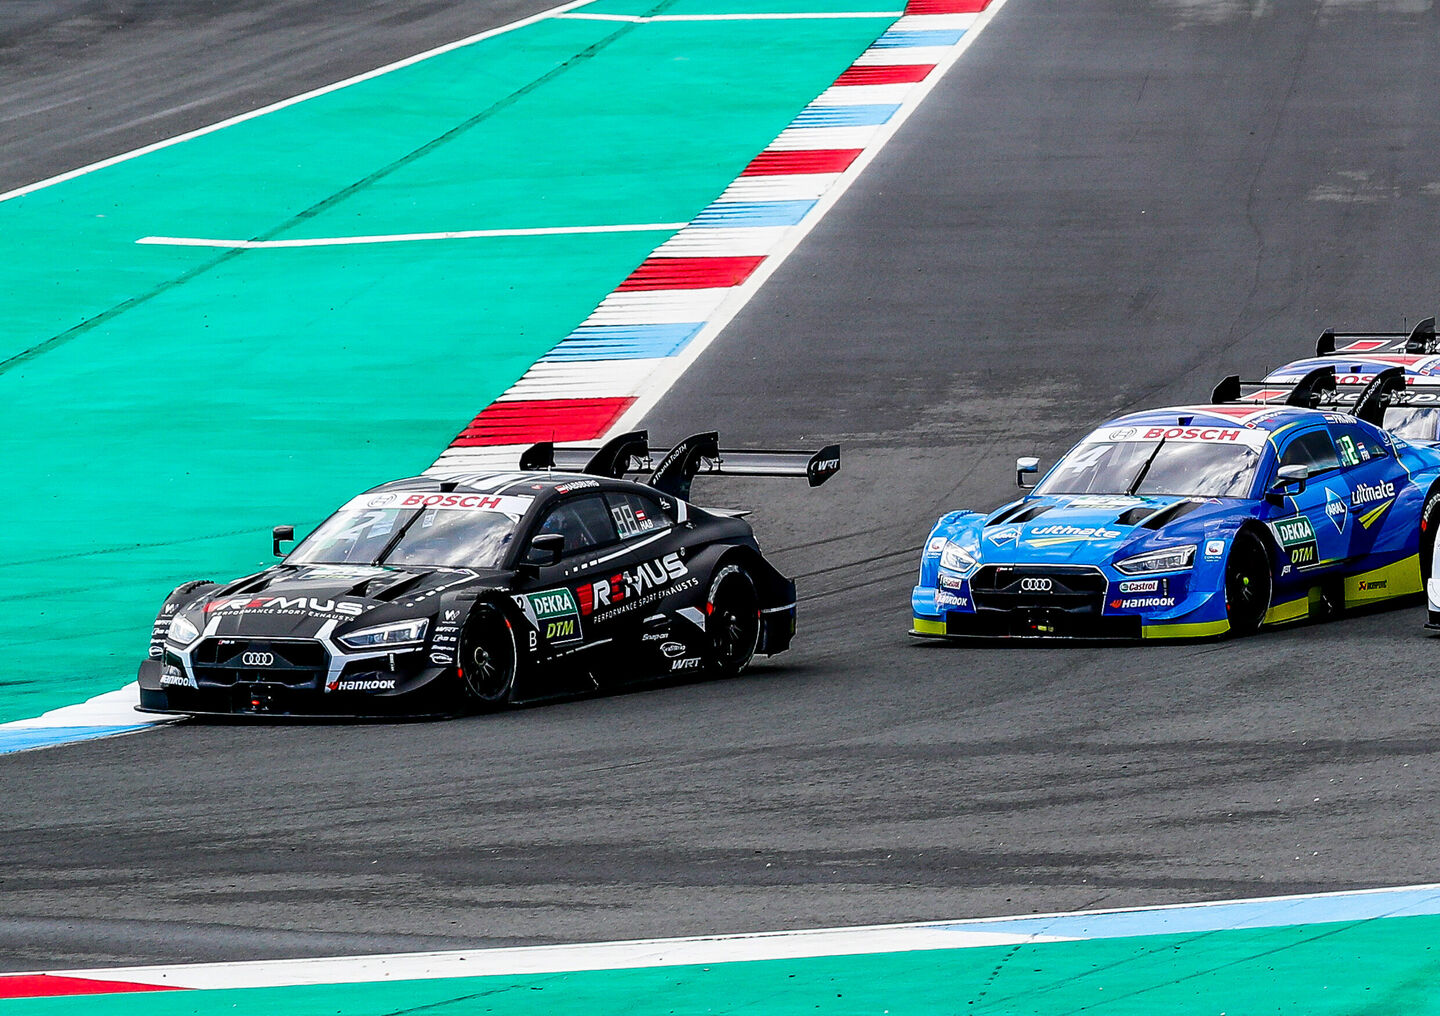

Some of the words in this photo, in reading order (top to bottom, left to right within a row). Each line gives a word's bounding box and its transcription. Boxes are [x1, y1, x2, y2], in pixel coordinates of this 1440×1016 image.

[1144, 427, 1241, 442] BOSCH
[1069, 444, 1114, 474] 4
[1351, 480, 1396, 505] ultimate
[401, 495, 503, 509] BOSCH
[1327, 500, 1346, 516] ARAL
[640, 518, 654, 531] HAB
[1030, 525, 1122, 540] ultimate
[1280, 520, 1312, 542] DEKRA
[1291, 546, 1313, 564] DTM
[593, 551, 689, 611] REMUS
[1128, 581, 1157, 592] Castrol
[217, 596, 364, 616] REMUS
[534, 595, 573, 615] DEKRA
[593, 600, 638, 624] PERFORMANCE
[638, 592, 657, 607] SPORT
[657, 577, 699, 600] EXHAUSTS
[211, 607, 274, 617] PERFORMANCE
[277, 608, 306, 616] SPORT
[546, 620, 574, 639] DTM
[672, 657, 702, 670] WRT
